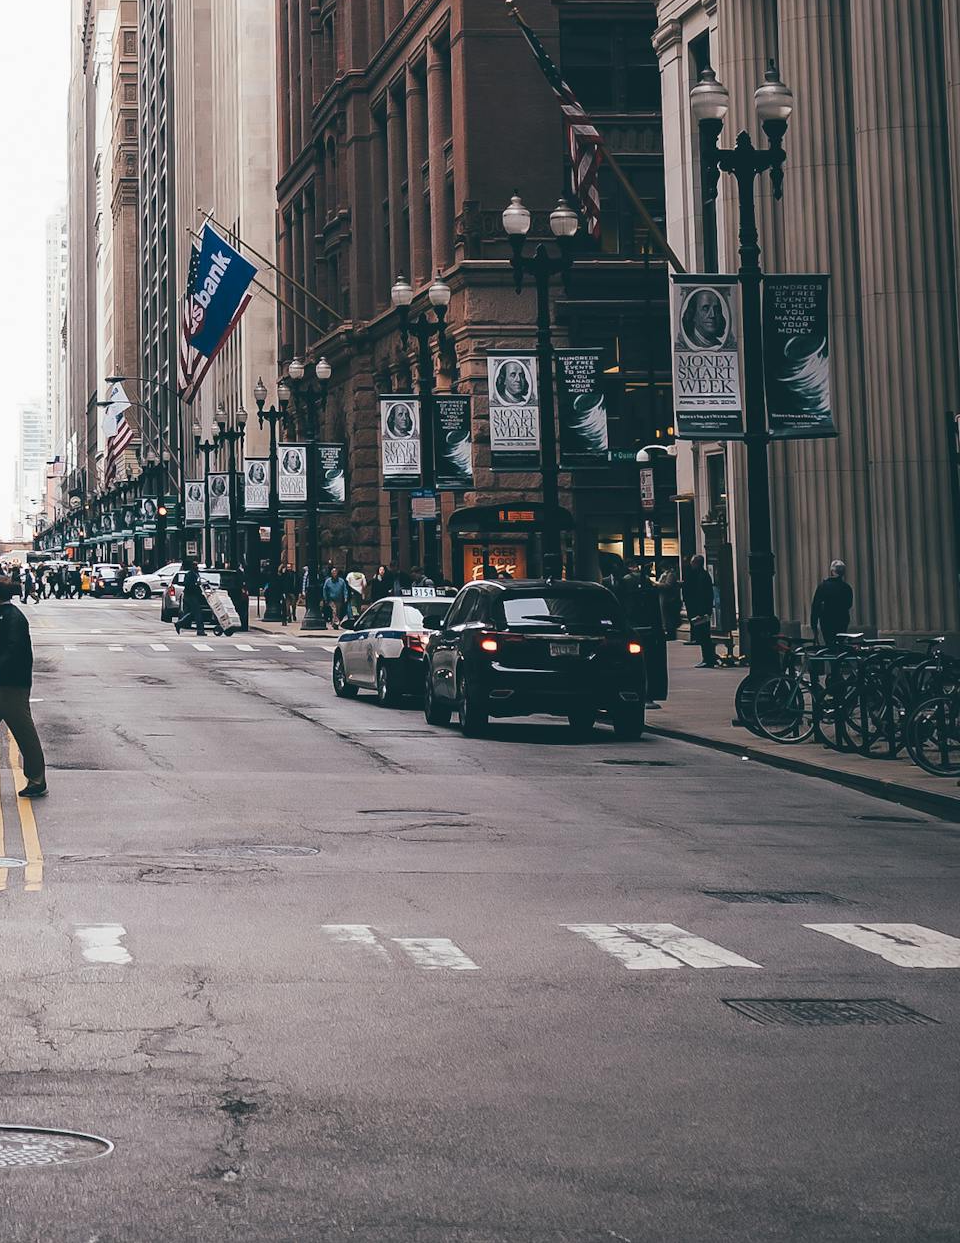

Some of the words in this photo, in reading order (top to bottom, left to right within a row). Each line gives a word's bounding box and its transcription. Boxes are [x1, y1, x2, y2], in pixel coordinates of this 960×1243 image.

[679, 356, 734, 367] MONEY
[678, 367, 734, 379] SMART
[679, 380, 736, 393] WEEK
[494, 410, 535, 418] MONEY
[494, 418, 536, 428] SMART
[494, 427, 536, 437] WEEK
[385, 448, 416, 456] SMART
[472, 548, 516, 557] BIGER
[472, 564, 517, 580] FEE
